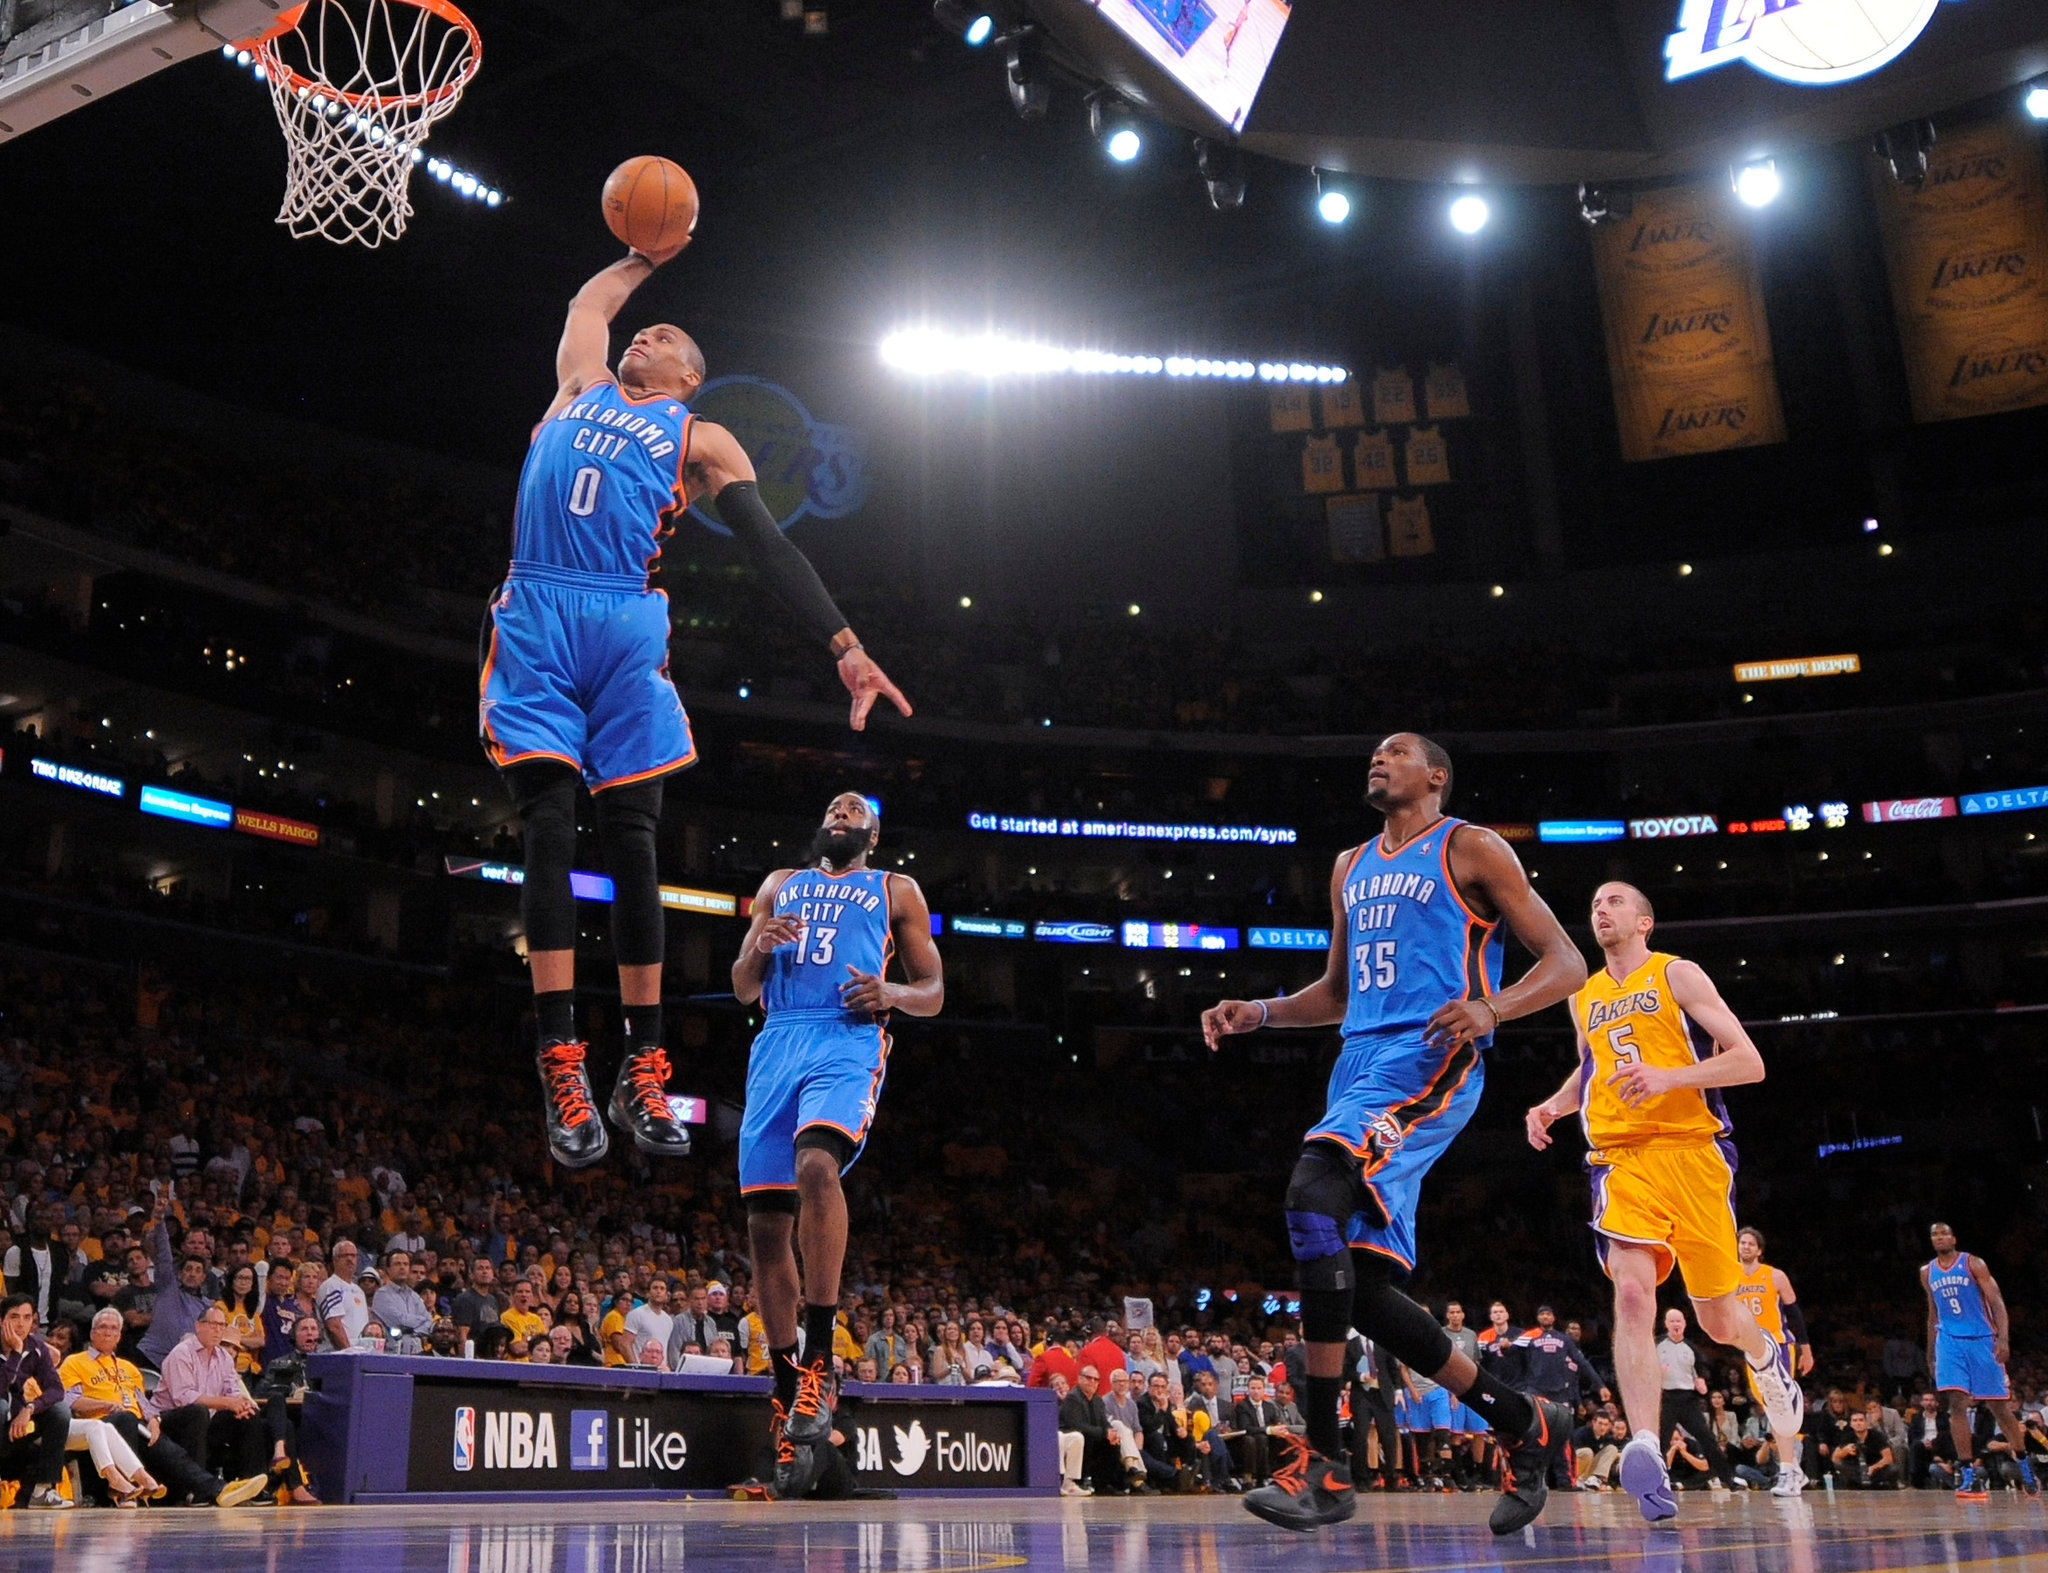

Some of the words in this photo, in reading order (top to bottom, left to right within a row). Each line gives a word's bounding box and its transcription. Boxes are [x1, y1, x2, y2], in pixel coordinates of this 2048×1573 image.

[1932, 156, 2005, 187] AKERS
[1932, 253, 2025, 289] LAKERS
[1642, 311, 1731, 343] LAKERS
[1950, 352, 2047, 387] LAKERS
[1657, 405, 1746, 438] LAKERS
[571, 427, 629, 461] CITY
[568, 466, 602, 517] 0
[1740, 666, 1768, 679] THE
[1770, 662, 1809, 676] HOME
[1811, 657, 1857, 673] DEPOT
[1786, 805, 1814, 821] LAL
[1822, 802, 1849, 817] OKC
[235, 813, 279, 832] WELLS
[280, 822, 318, 840] FARGO
[969, 813, 997, 831] Get
[1000, 818, 1058, 834] started
[1061, 820, 1080, 835] at
[1083, 822, 1298, 844] americanexpress.com/sync
[1541, 825, 1586, 836] American
[1586, 825, 1624, 837] Express
[1630, 816, 1718, 838] TOYOTA
[660, 891, 679, 903] THE
[706, 897, 735, 911] DEPOT
[779, 883, 880, 913] OKLAHOMA
[800, 902, 845, 924] CITY
[953, 919, 1002, 935] Panasonic
[1006, 923, 1025, 934] 3D
[1357, 903, 1399, 933] CITY
[795, 926, 837, 966] 13
[1269, 930, 1328, 946] DELTA
[1354, 940, 1397, 993] 35
[1588, 989, 1661, 1032] LAKERS
[1607, 1023, 1642, 1071] 5
[1950, 1297, 1962, 1315] 9
[484, 1411, 558, 1469] NBA
[618, 1417, 687, 1470] Like
[856, 1427, 883, 1471] BA
[936, 1431, 1012, 1472] Follow
